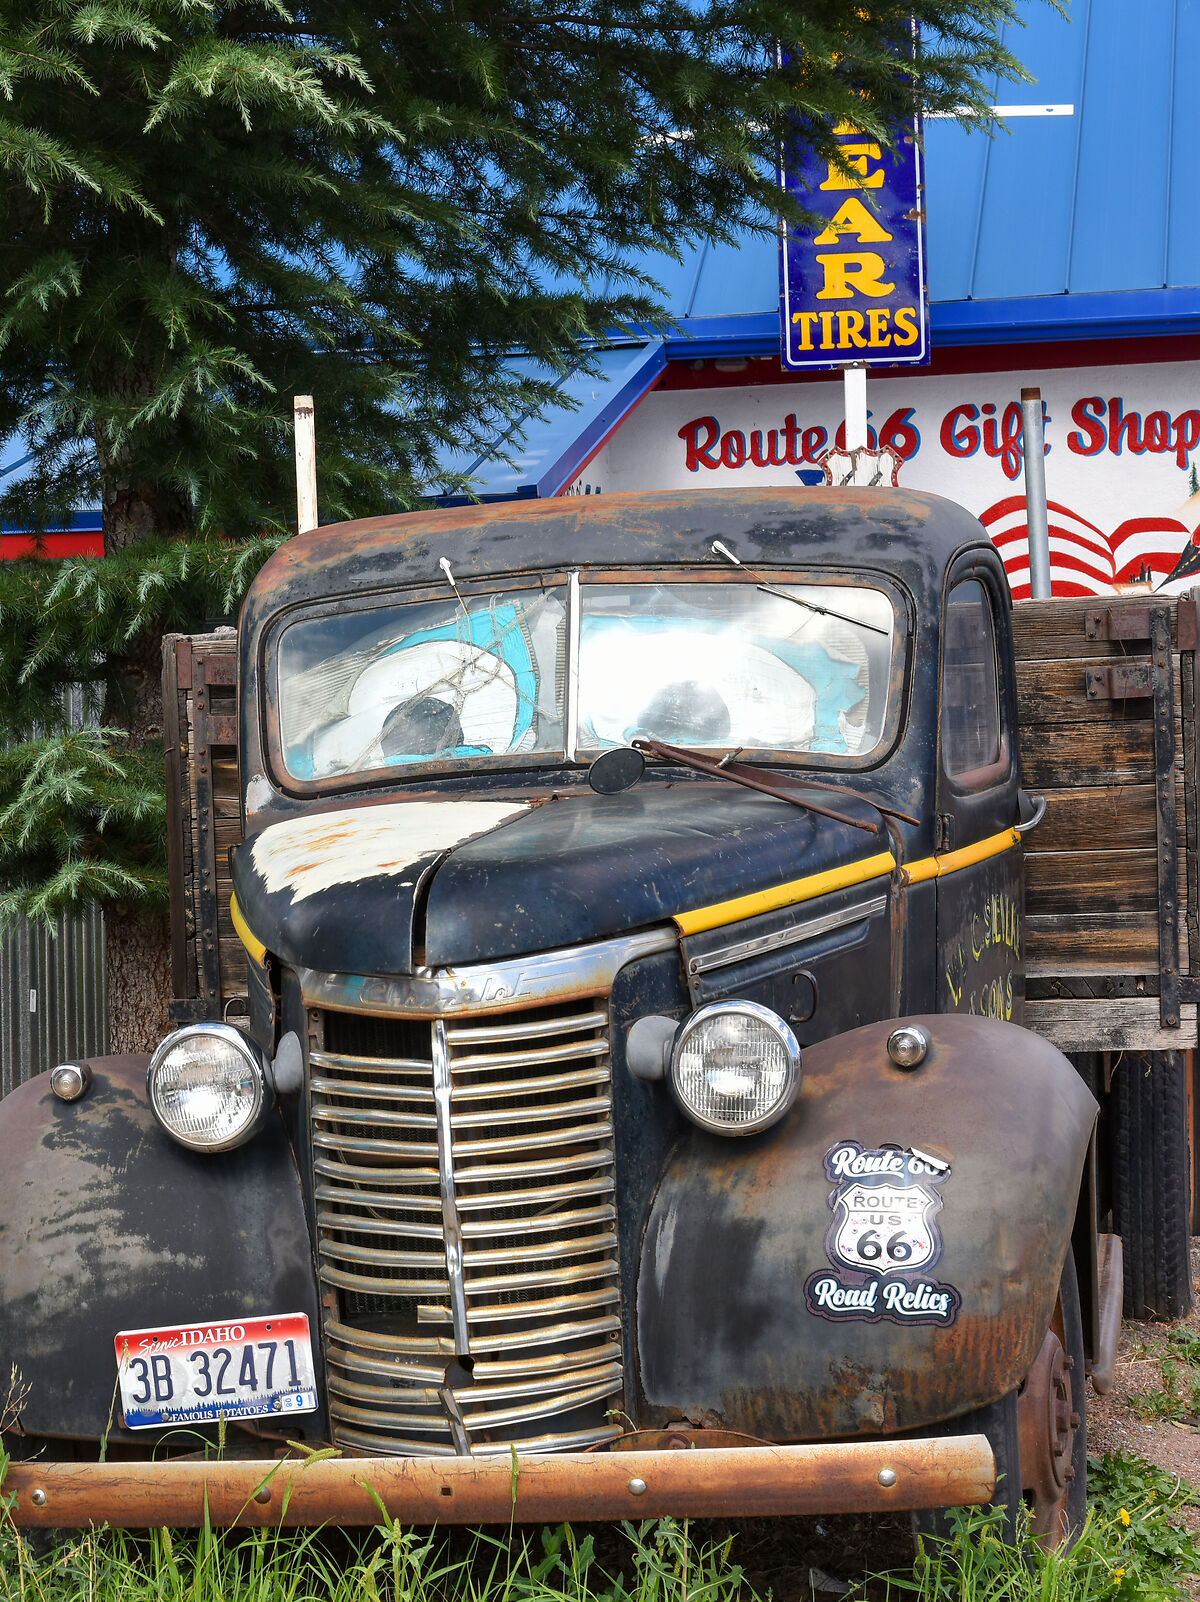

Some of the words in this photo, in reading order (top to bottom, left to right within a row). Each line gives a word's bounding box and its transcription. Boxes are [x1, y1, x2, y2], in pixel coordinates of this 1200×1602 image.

[791, 307, 919, 351] TIRES
[677, 412, 829, 473] Route
[1066, 396, 1200, 471] Shop
[831, 1147, 905, 1179] Route
[853, 1195, 918, 1209] ROUTE
[869, 1213, 902, 1226] US
[856, 1229, 913, 1262] 66
[814, 1278, 879, 1313] Road
[882, 1281, 952, 1317] Relics
[139, 1335, 184, 1355] Scenic
[180, 1325, 246, 1347] IDAHO
[129, 1354, 175, 1404] 3B
[189, 1339, 302, 1397] 32471
[171, 1409, 214, 1423] FAMOUS
[215, 1404, 269, 1419] POTATOES
